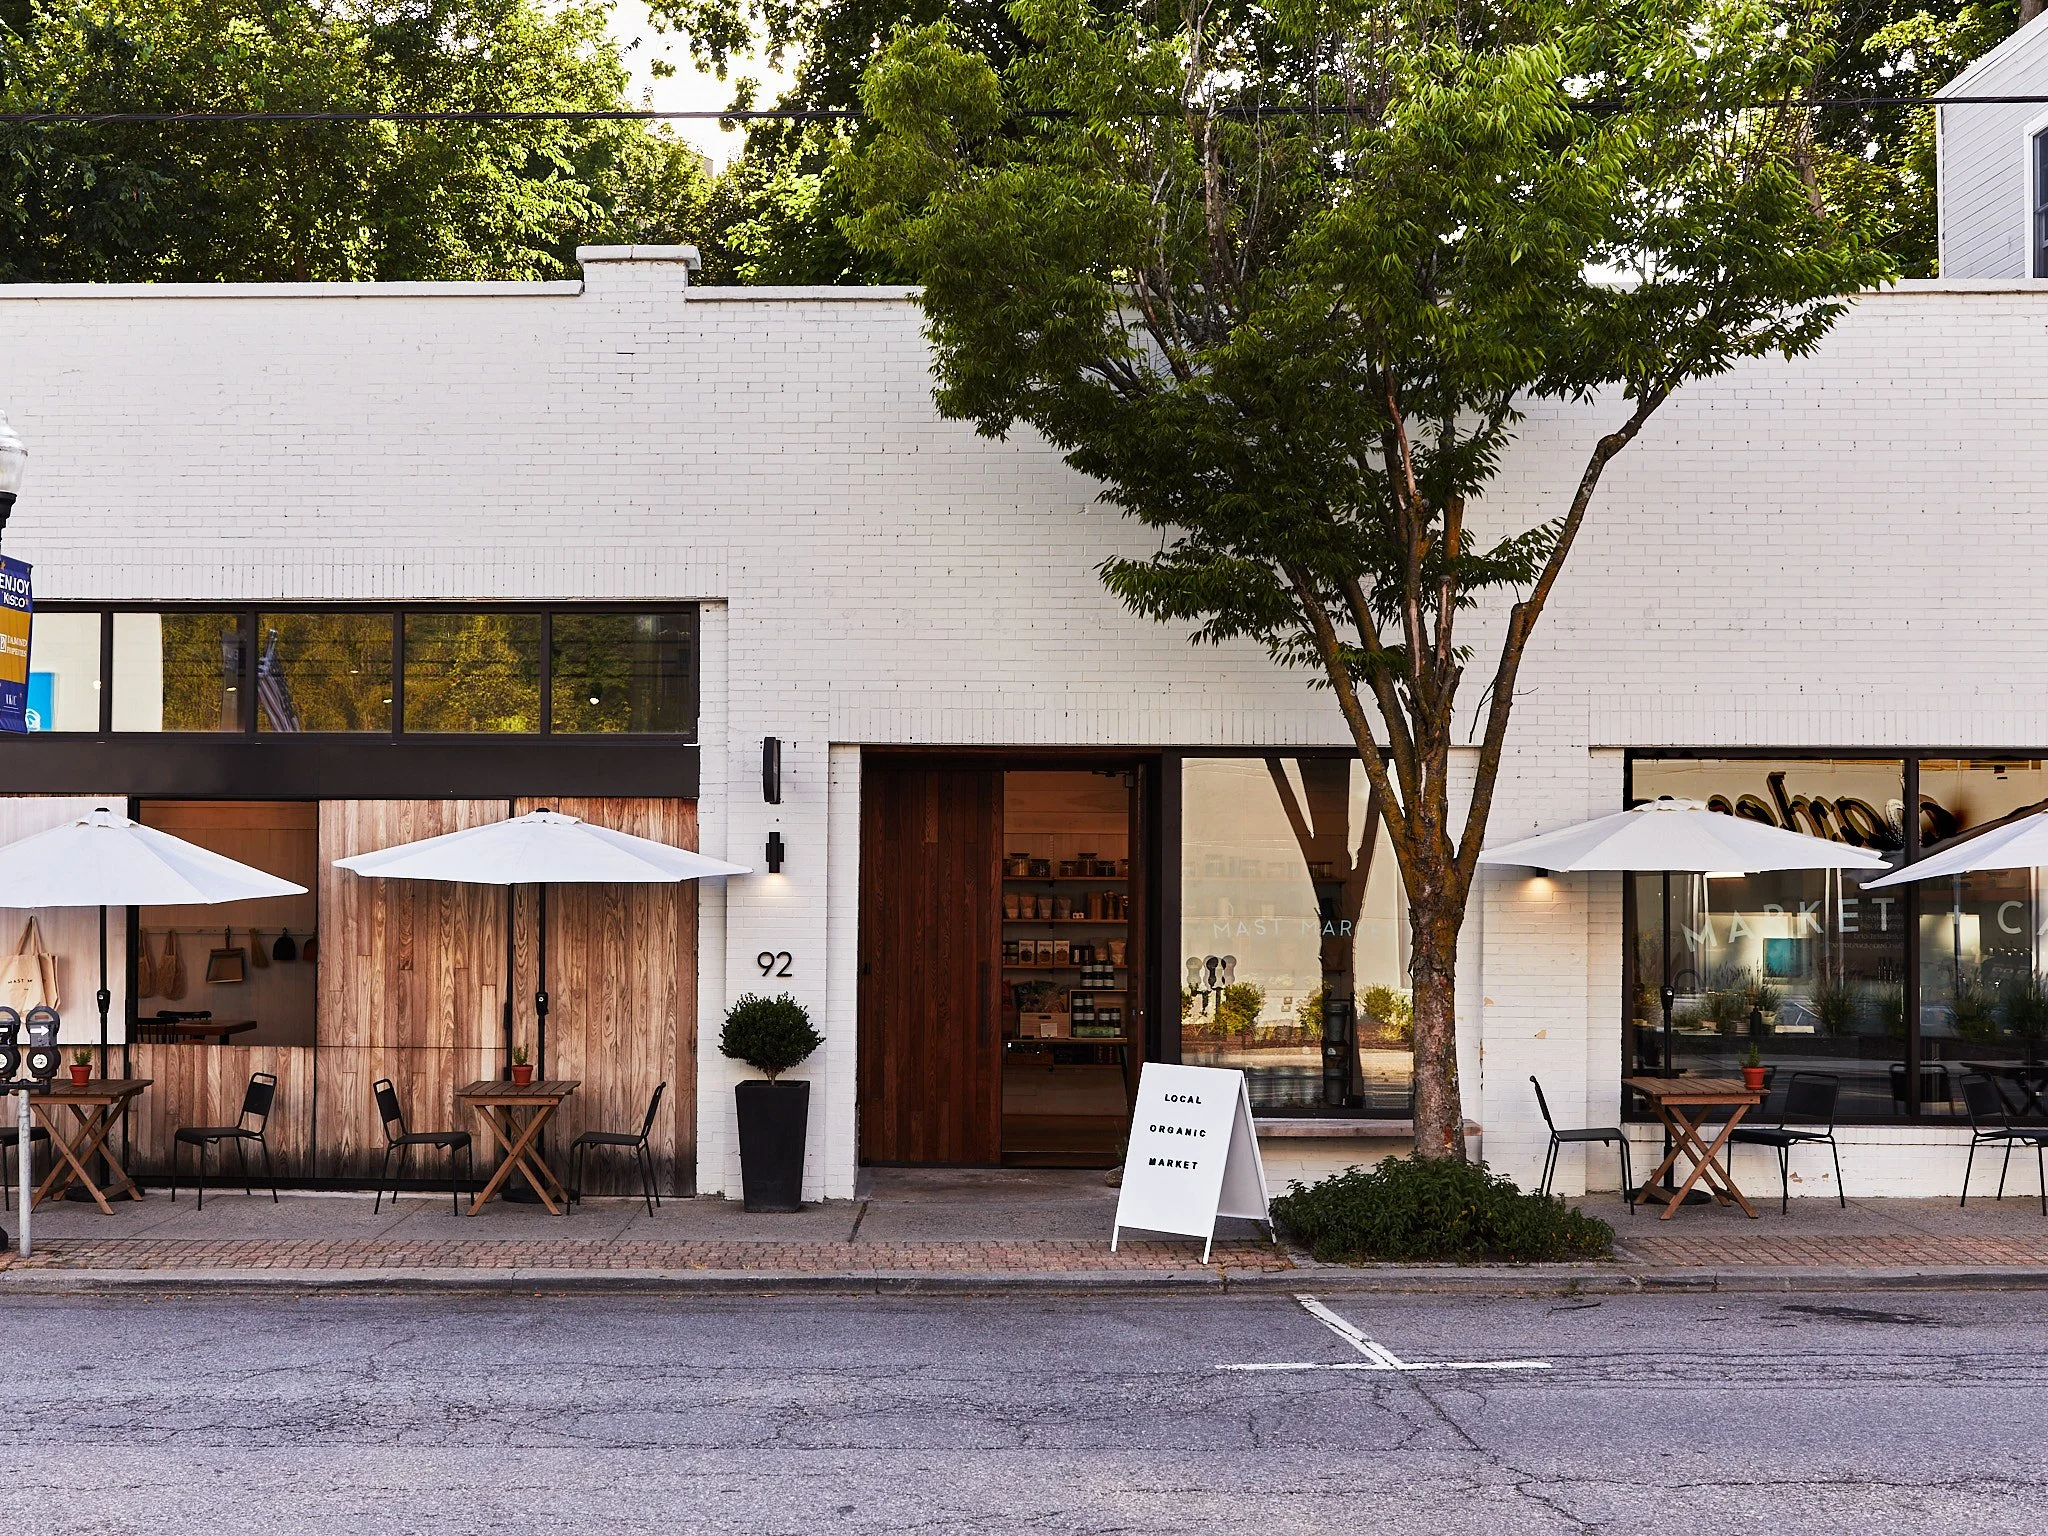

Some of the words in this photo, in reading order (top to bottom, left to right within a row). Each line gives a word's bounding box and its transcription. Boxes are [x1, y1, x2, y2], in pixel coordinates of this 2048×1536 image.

[0, 572, 30, 596] ENJOY
[1213, 918, 1282, 939] MAST
[1680, 898, 1895, 952] MARKET
[757, 951, 793, 977] 92
[1164, 1093, 1202, 1105] LOCAL
[1149, 1124, 1207, 1138] ORGANIC
[1148, 1157, 1199, 1170] MARKET
